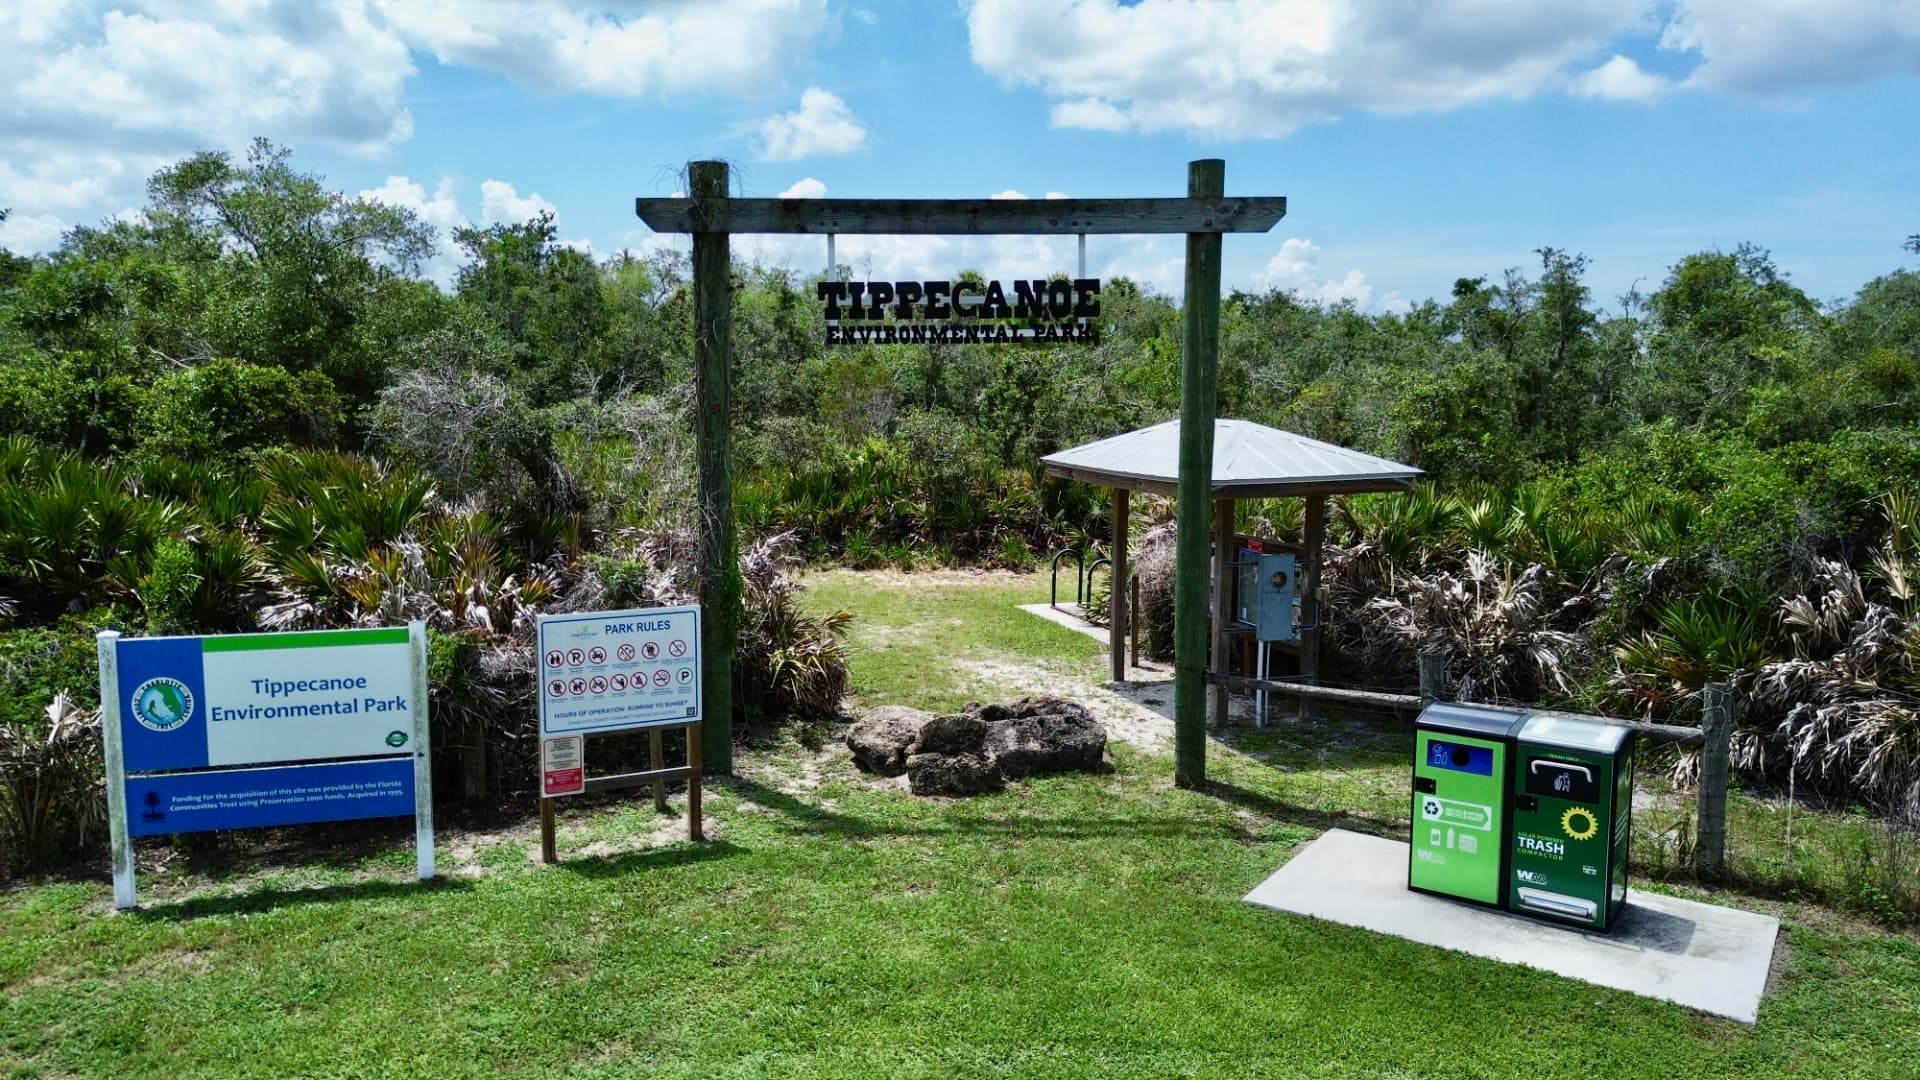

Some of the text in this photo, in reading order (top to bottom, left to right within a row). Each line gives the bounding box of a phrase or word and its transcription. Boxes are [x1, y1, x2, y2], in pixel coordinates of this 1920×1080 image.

[817, 278, 1101, 321] TIPPECANOE
[827, 322, 1093, 345] ENVIRONMENTAL PARK
[605, 620, 671, 635] PARK RULES
[251, 677, 367, 698] Tippecanoe
[211, 695, 407, 722] Environmental Park
[554, 711, 577, 719] HOURS
[578, 709, 586, 717] OF
[627, 703, 653, 711] SUNRISE
[664, 699, 688, 707] SUNSET
[169, 803, 218, 812] Communities
[219, 801, 238, 809] Trust
[238, 800, 259, 808] using
[260, 795, 305, 806] Preservation
[324, 793, 345, 801] funds.
[347, 790, 378, 800] Acquired
[172, 794, 202, 803] Funding
[229, 789, 268, 800] acquisition
[269, 788, 278, 796] of
[293, 786, 306, 794] site
[323, 783, 353, 793] provided
[354, 783, 364, 791] by
[365, 781, 377, 789] the
[378, 780, 402, 788] Florida
[1517, 836, 1564, 855] TRASH
[1518, 831, 1564, 844] SOLAR POWERED
[1516, 847, 1564, 861] COMPACTOR
